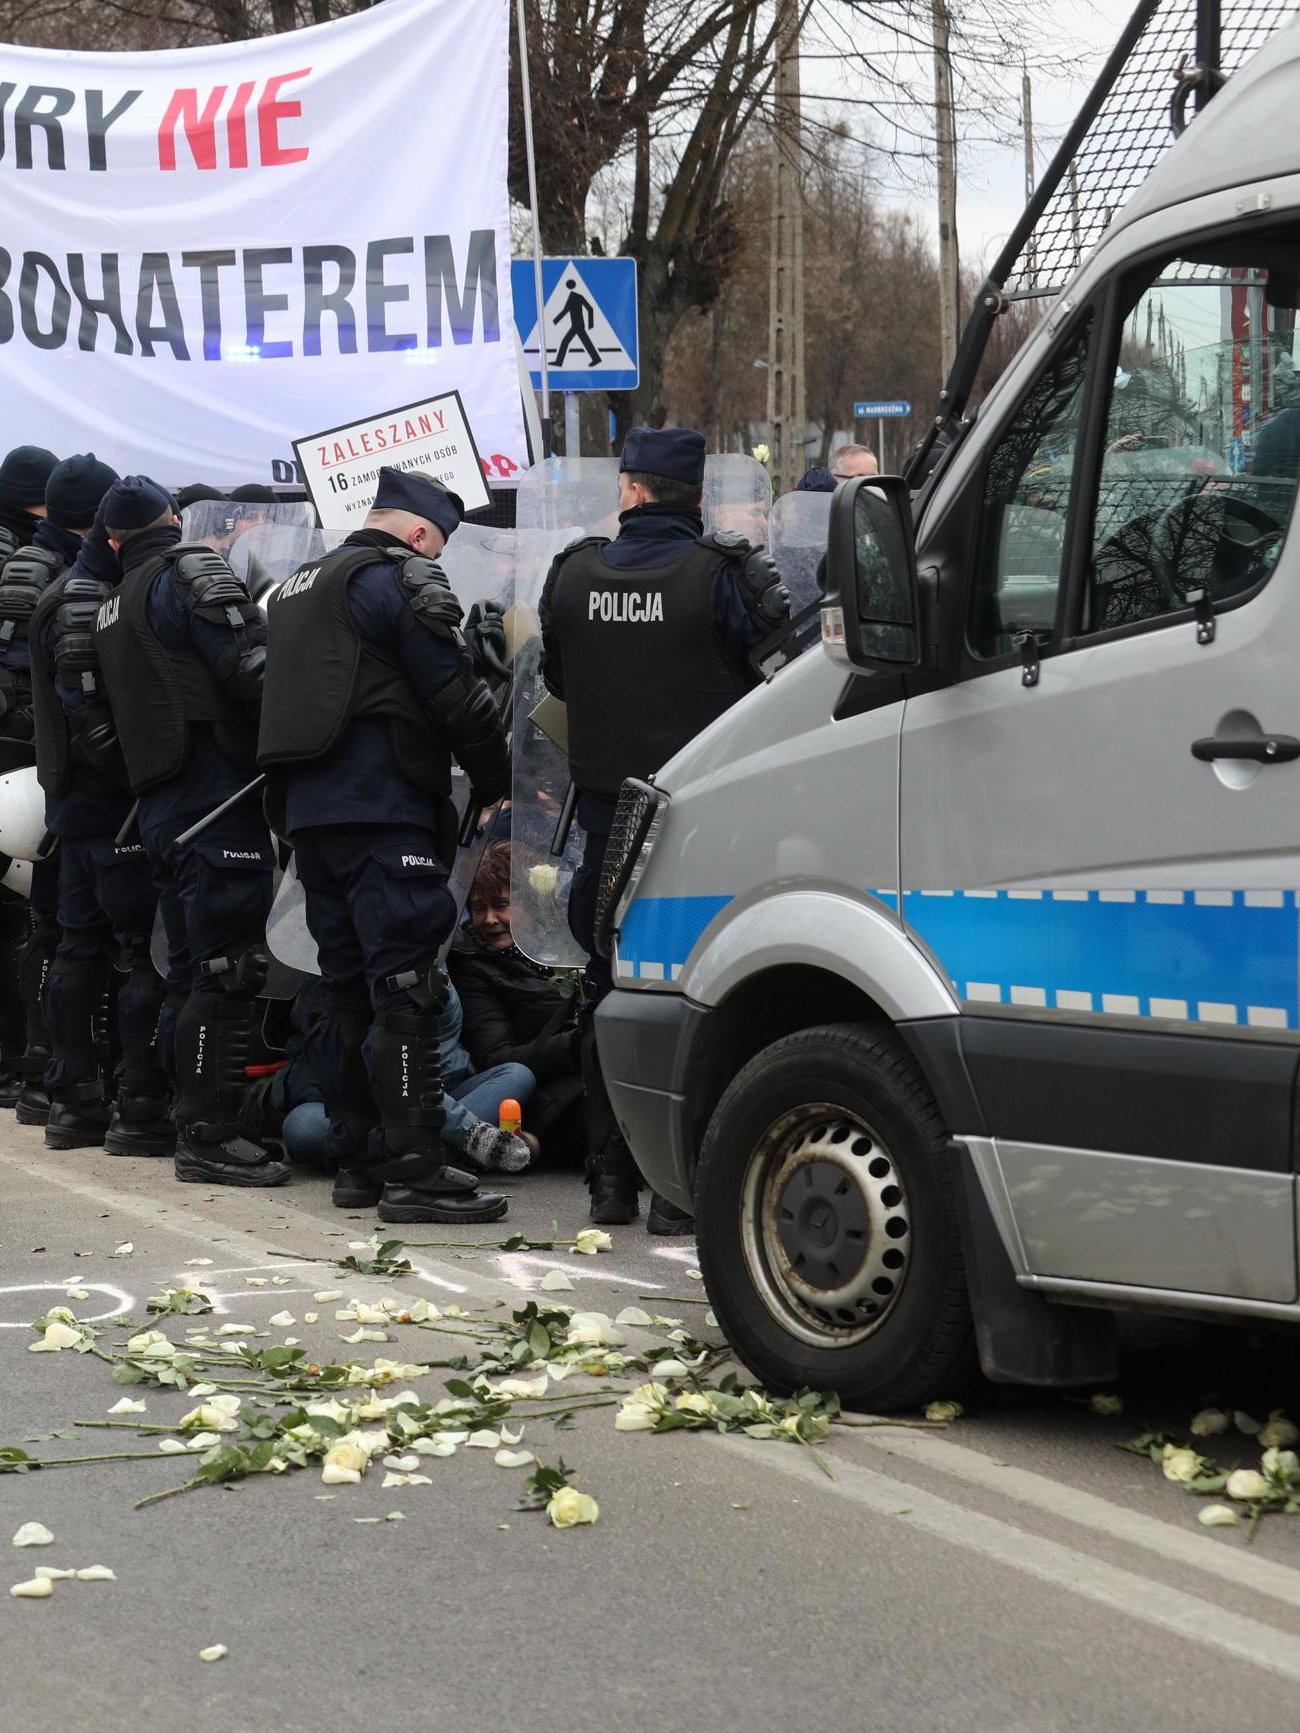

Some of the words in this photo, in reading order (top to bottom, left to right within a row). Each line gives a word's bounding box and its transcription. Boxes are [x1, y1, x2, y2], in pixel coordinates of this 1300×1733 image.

[157, 67, 313, 172] NIE
[317, 410, 445, 467] ZALESZANY
[328, 472, 349, 494] 16
[433, 445, 458, 460] OSÓB
[276, 566, 322, 602] POLICJA
[588, 591, 664, 623] POLICJA
[96, 595, 120, 633] POLICJA
[195, 1025, 207, 1074] POLICJA
[401, 1045, 409, 1097] POLICJA
